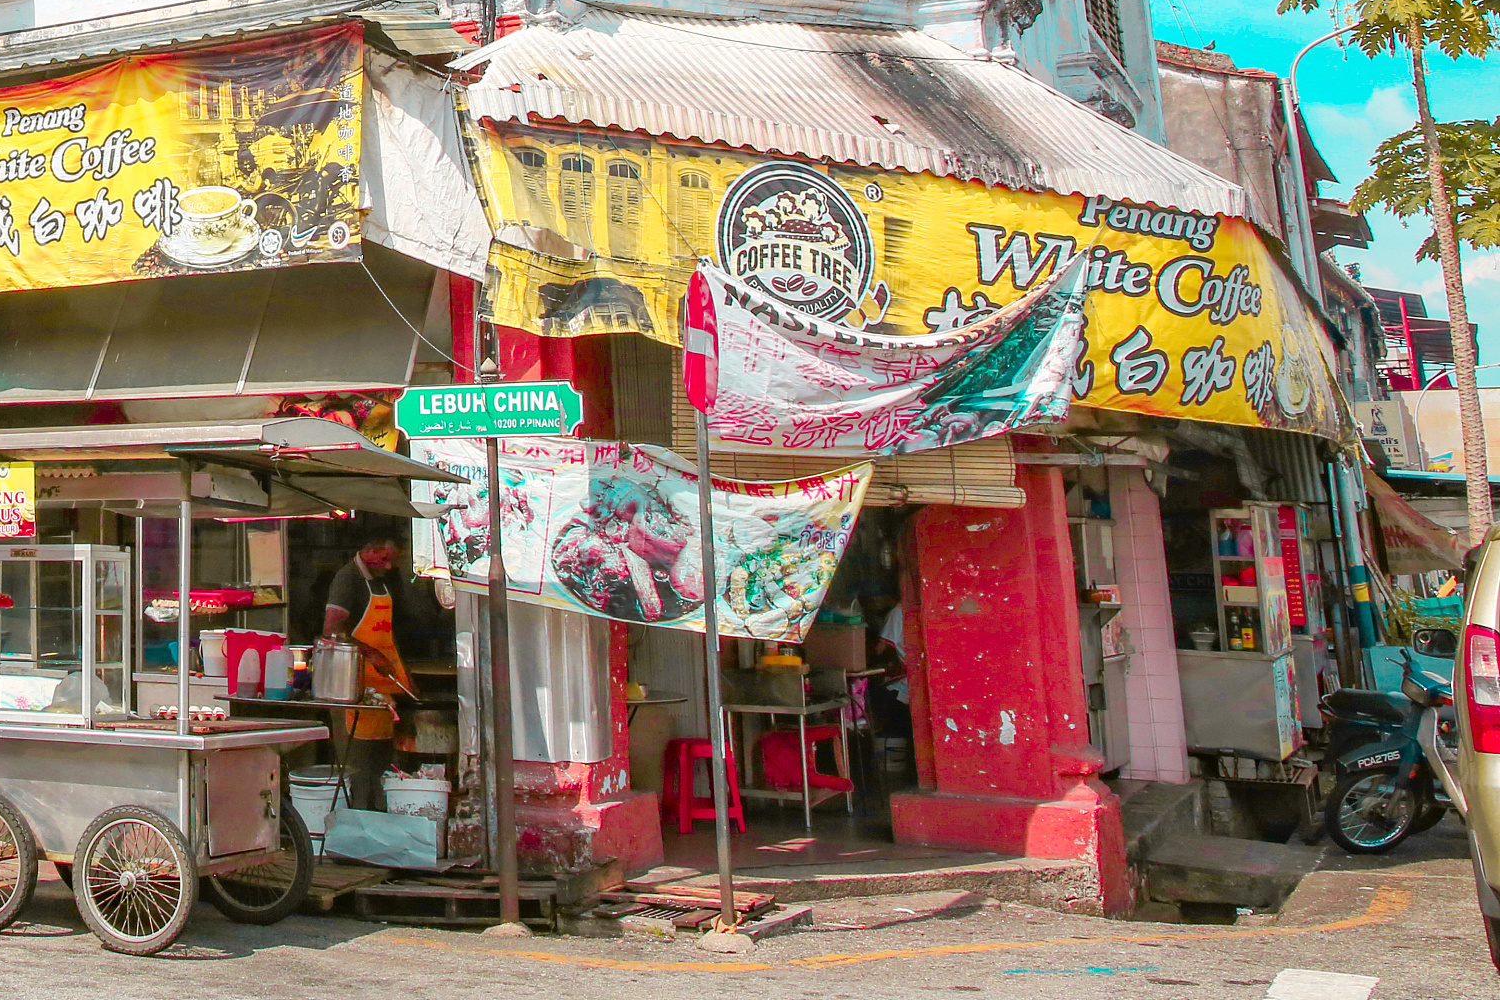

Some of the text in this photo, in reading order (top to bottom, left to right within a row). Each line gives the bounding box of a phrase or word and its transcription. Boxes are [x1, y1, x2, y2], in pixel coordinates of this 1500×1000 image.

[1, 103, 87, 137] Penang
[337, 85, 355, 183] 道地咖啡香
[50, 128, 157, 182] Coffee
[1078, 194, 1221, 252] Penang
[736, 243, 802, 277] COFFEE
[809, 248, 853, 296] TREE
[1155, 255, 1263, 326] Coffee
[723, 282, 818, 337] NASI
[798, 288, 839, 314] QUALITY
[419, 390, 559, 415] LEBUH CHINA
[493, 418, 517, 429] 10200
[519, 417, 561, 428] P.PINANG
